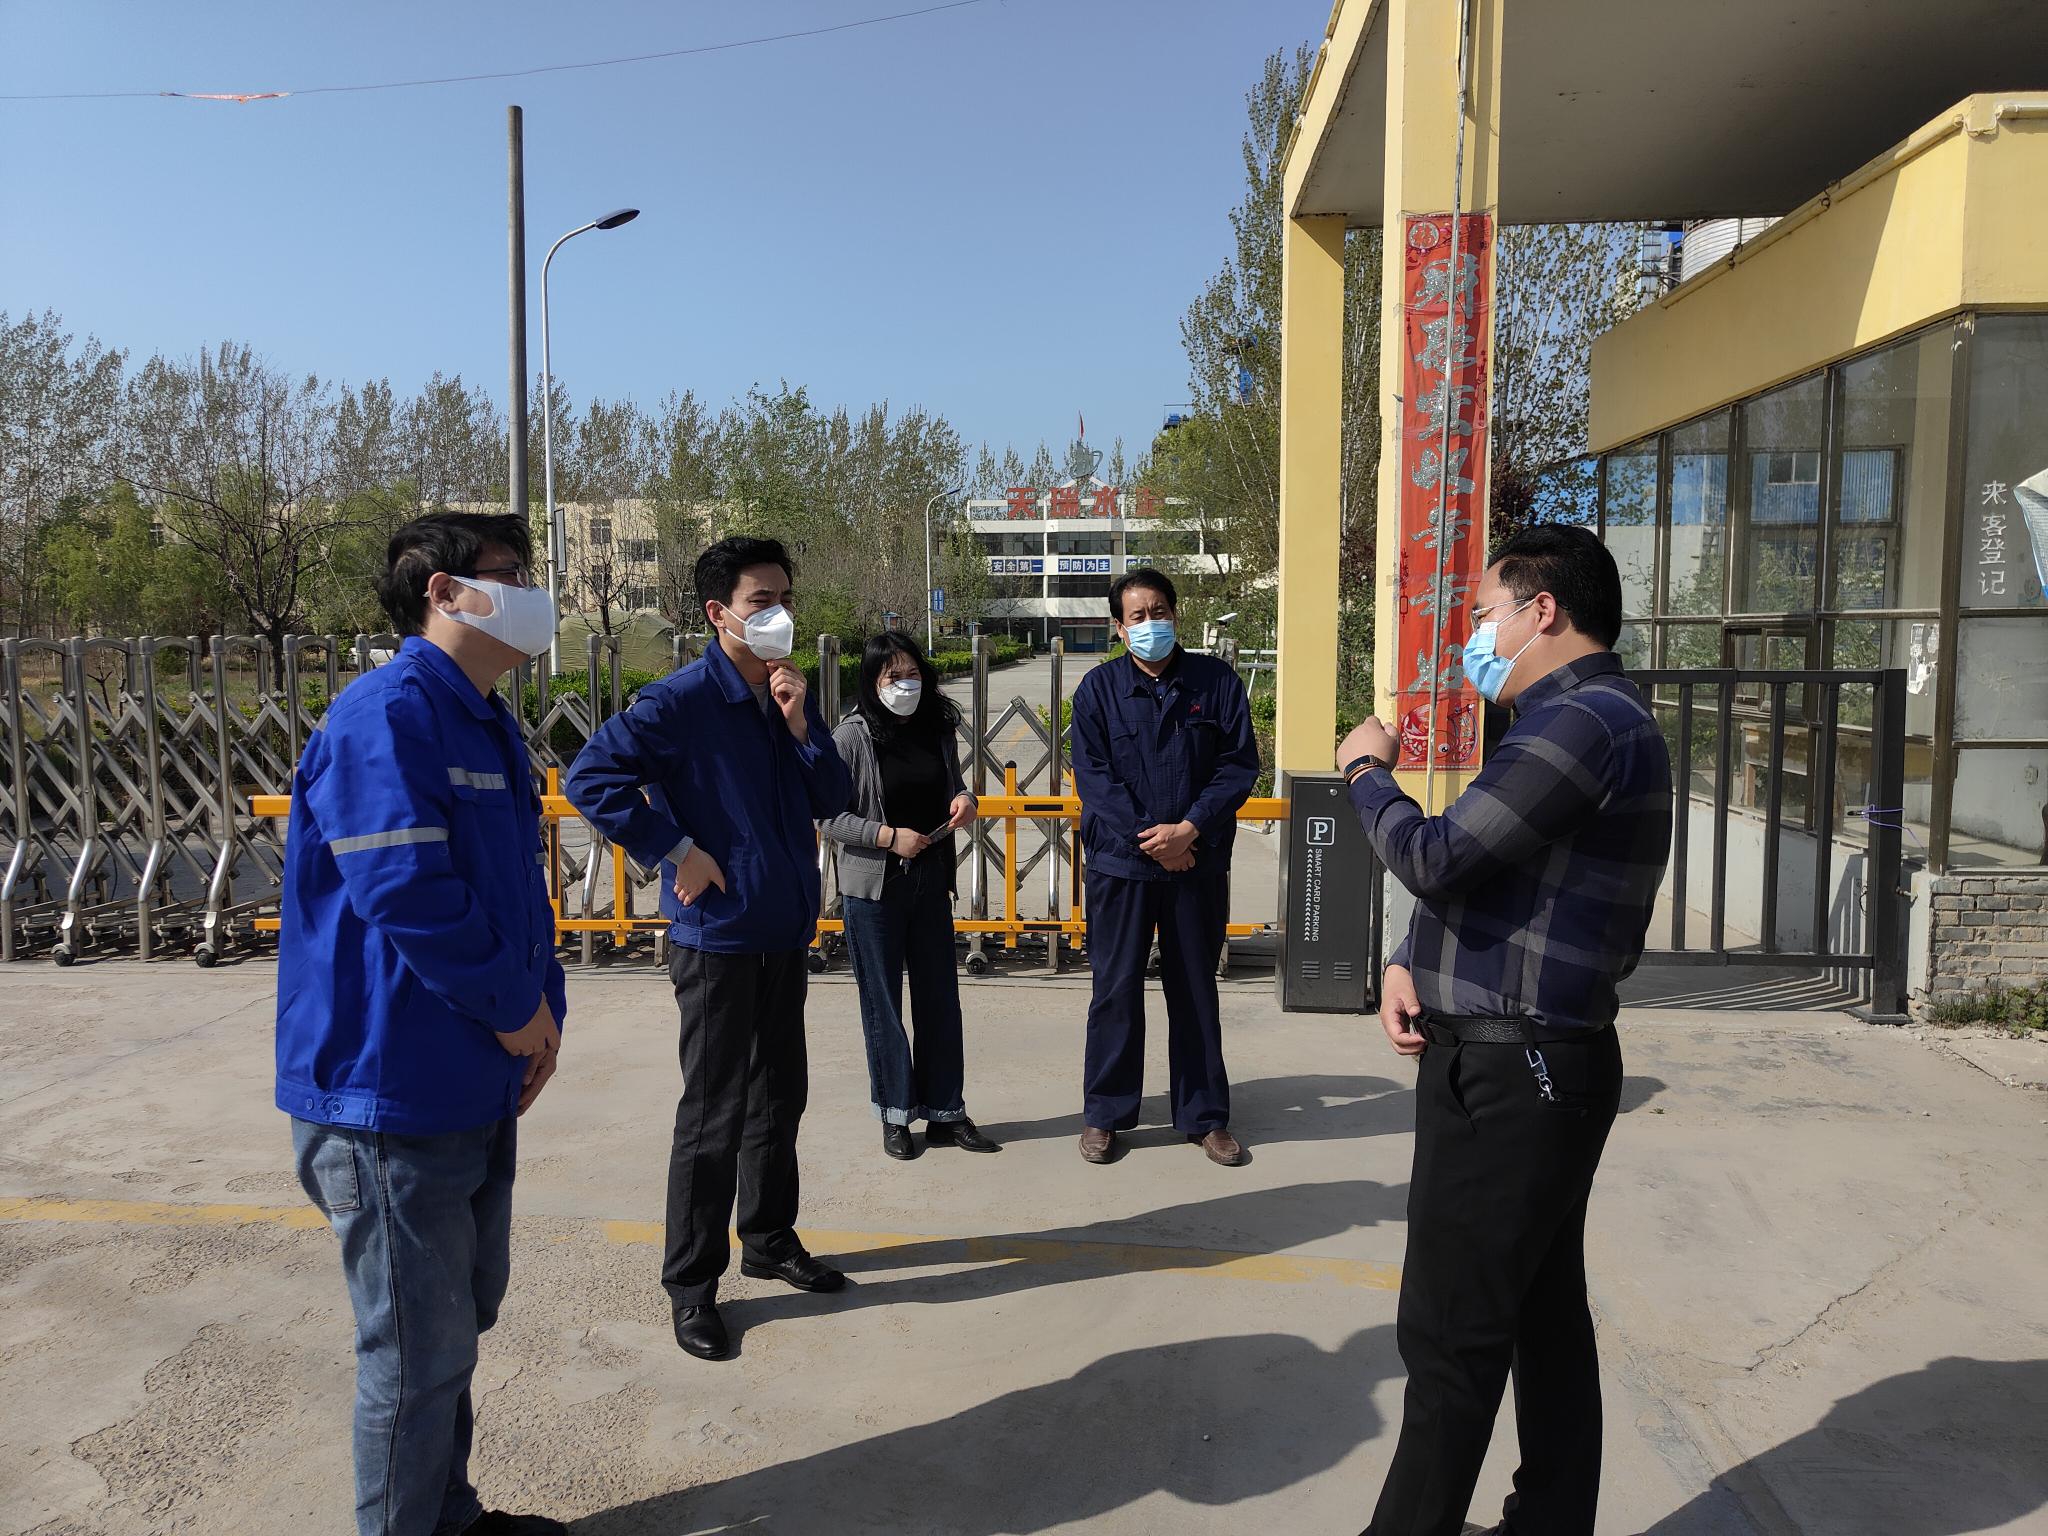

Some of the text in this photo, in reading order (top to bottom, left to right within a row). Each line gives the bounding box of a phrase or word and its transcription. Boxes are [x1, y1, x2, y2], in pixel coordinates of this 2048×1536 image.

[992, 559, 1109, 573] 安全第一 预防为主
[1978, 480, 2008, 596] 来客登记
[1313, 821, 1329, 841] P
[1311, 848, 1323, 942] SMART CARD PARKING
